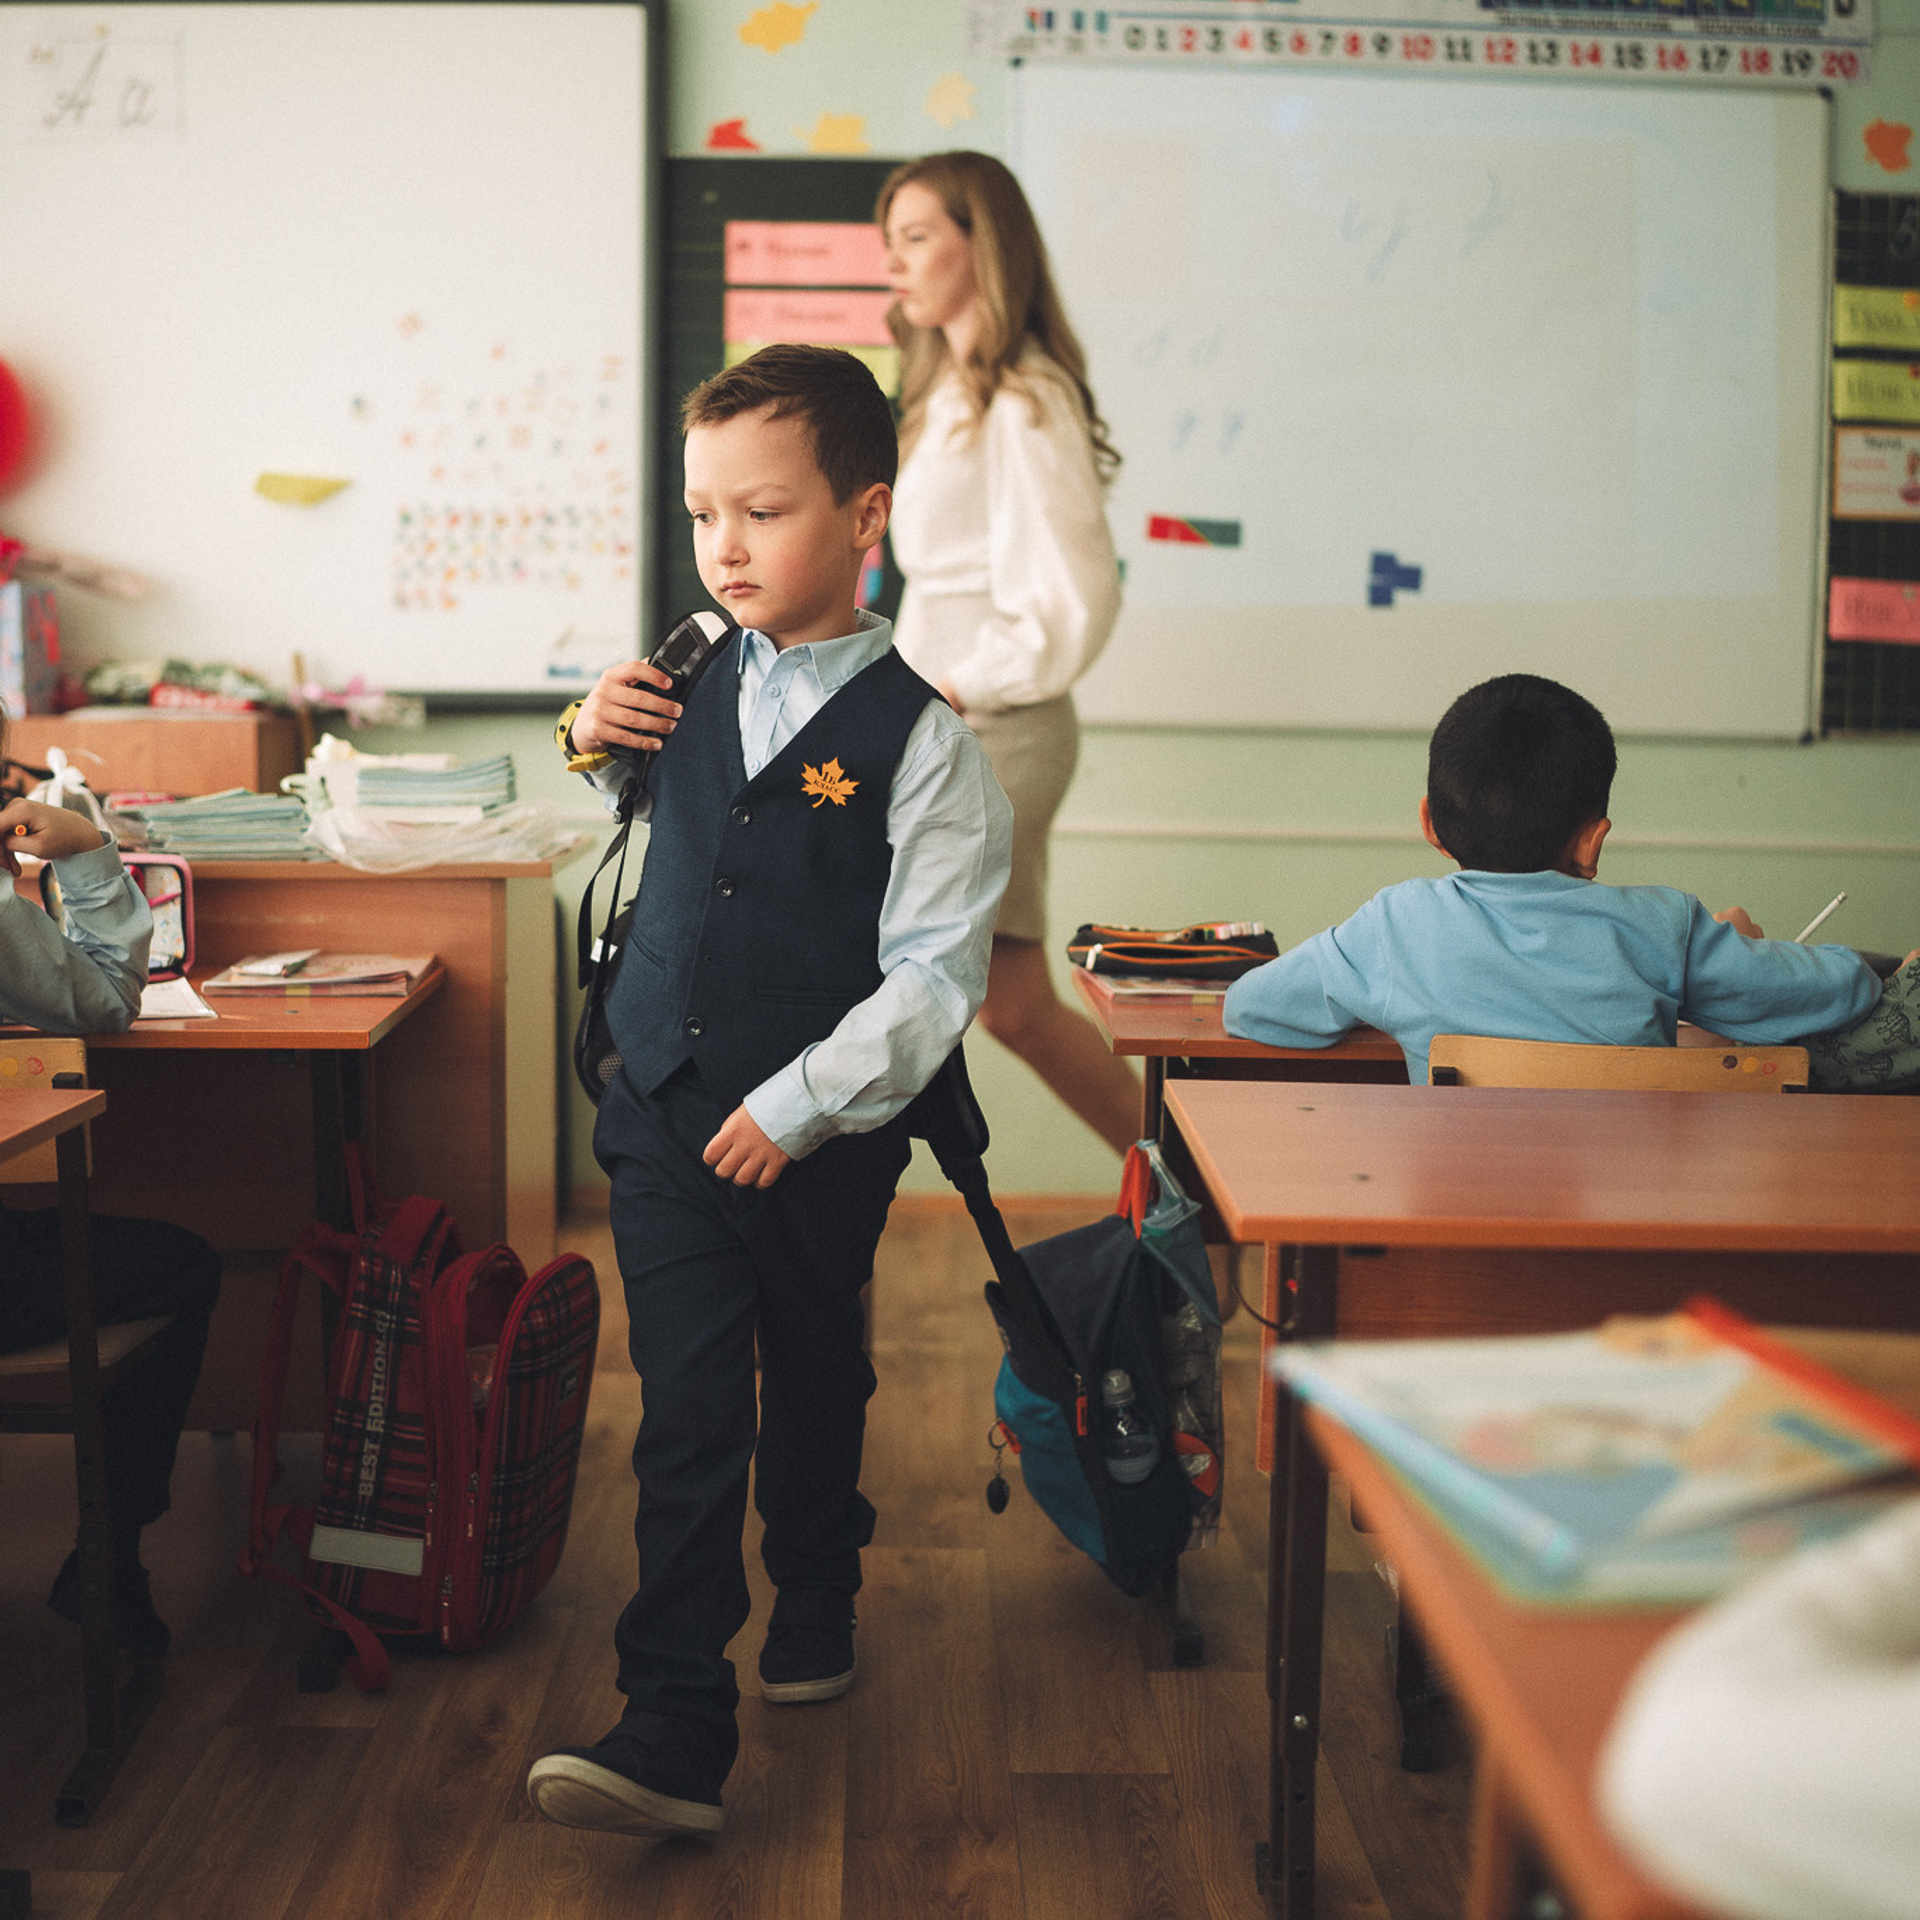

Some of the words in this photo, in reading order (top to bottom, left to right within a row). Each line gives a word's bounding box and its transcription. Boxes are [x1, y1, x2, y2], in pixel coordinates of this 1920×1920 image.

[1125, 26, 1145, 50] 0
[1156, 28, 1168, 51] 1
[1179, 27, 1197, 52] 2
[1206, 28, 1224, 52] 3
[1233, 28, 1252, 52] 4
[1264, 28, 1281, 52] 5
[1289, 30, 1310, 55] 6
[1319, 31, 1336, 56] 7
[1344, 32, 1363, 57] 8
[1371, 33, 1391, 58] 9
[1402, 35, 1435, 60] 10
[1445, 37, 1472, 62] 11
[1486, 38, 1517, 63] 12
[1528, 40, 1559, 65] 13
[1571, 43, 1602, 66] 14
[1615, 43, 1645, 69] 15
[1657, 45, 1689, 70] 16
[1700, 47, 1730, 71] 17
[1742, 49, 1771, 74] 18
[1783, 50, 1813, 75] 19
[1822, 51, 1858, 79] 20
[358, 1438, 381, 1497] BEST
